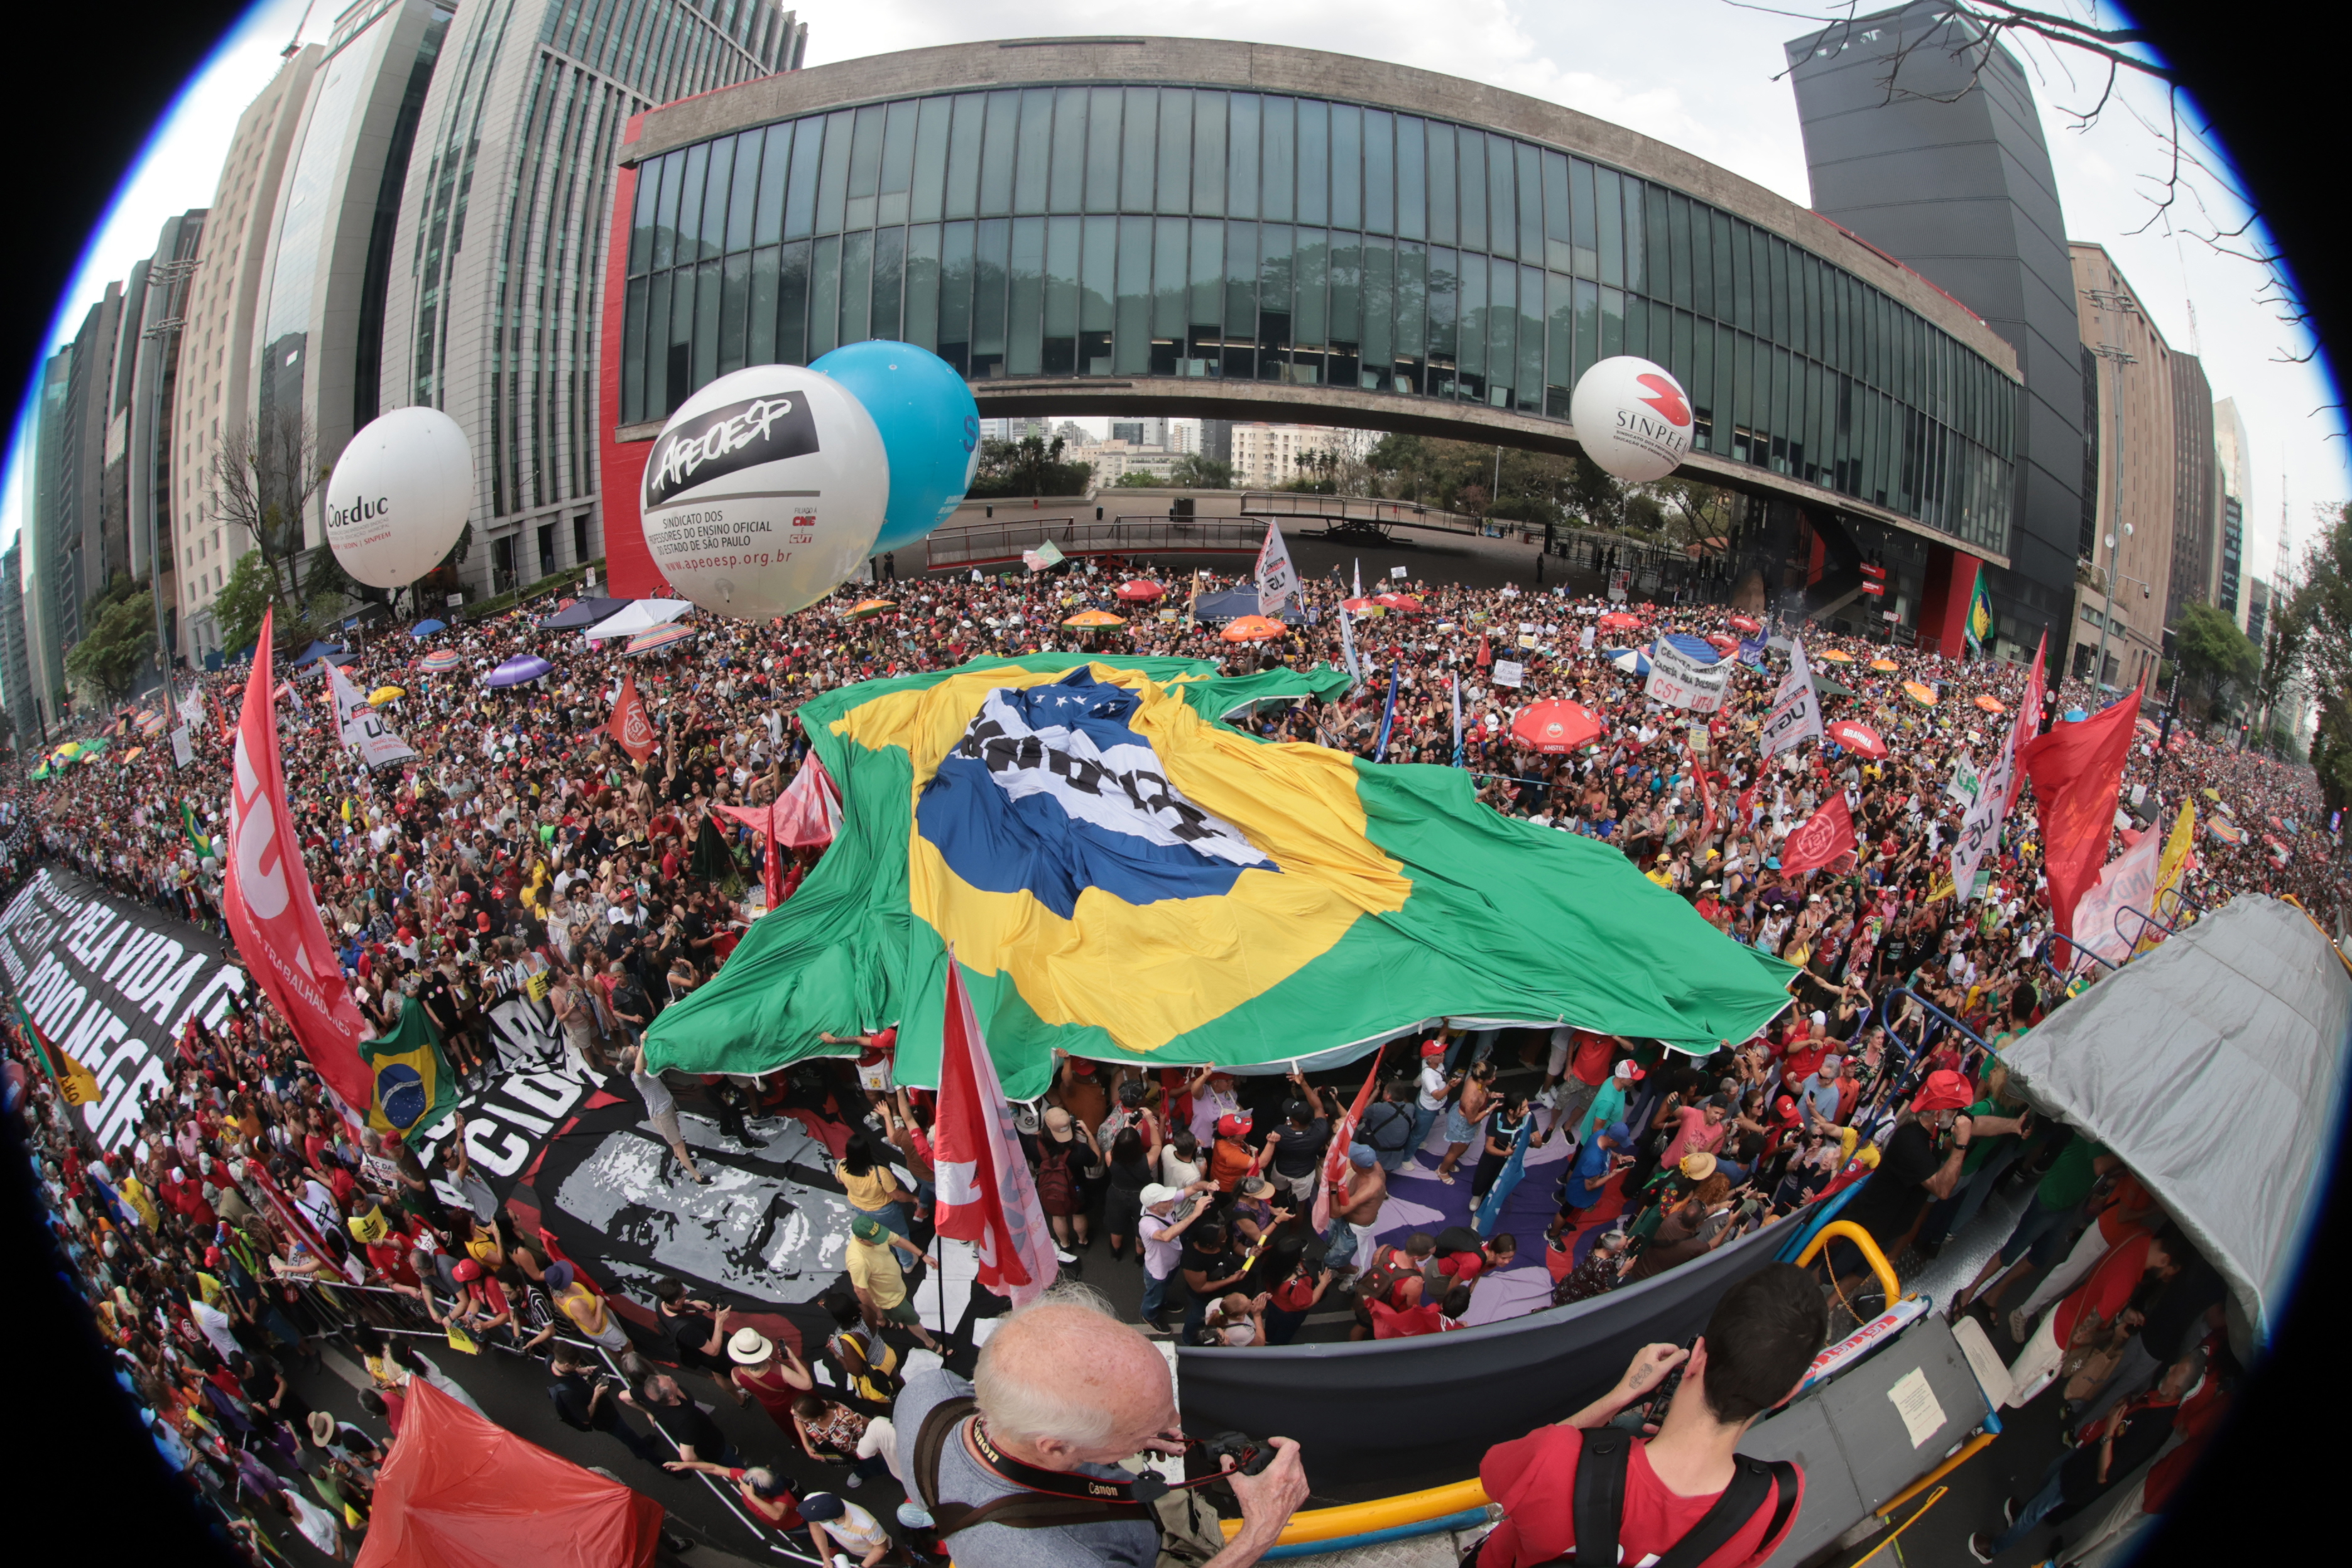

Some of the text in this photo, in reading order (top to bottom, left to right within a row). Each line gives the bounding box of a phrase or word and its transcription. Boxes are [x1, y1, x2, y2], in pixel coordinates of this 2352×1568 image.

[651, 399, 792, 490] APEOESP
[1613, 435, 1639, 446] EDUCAÇÃO
[1616, 430, 1643, 442] SINDICATO
[663, 510, 722, 529] SINDICATO DOS
[343, 542, 358, 550] SEDIN
[364, 531, 391, 545] SINPEEM
[648, 521, 772, 545] PROFESSORES DO ENSINO OFICIAL
[790, 534, 813, 543] CUT
[657, 535, 751, 555] DO ESTADO DE SÃO PAULO
[665, 548, 792, 572] www.apeoesp.org.br
[1883, 611, 1899, 623] MASP
[1653, 678, 1683, 702] CST
[2168, 675, 2179, 707] Pamplona
[369, 738, 387, 748] UNIÃO
[1516, 734, 1530, 747] AMSTEL
[1579, 737, 1595, 748] AMSTEL
[1842, 727, 1872, 749] BRAHMA
[60, 900, 131, 973] PELA
[102, 926, 209, 1026] VIDA
[16, 950, 88, 1043] POVO
[264, 939, 351, 1037] TRABALHADORES
[425, 1236, 435, 1251] PT
[973, 1418, 999, 1464] Canon
[1088, 1481, 1119, 1498] Canon
